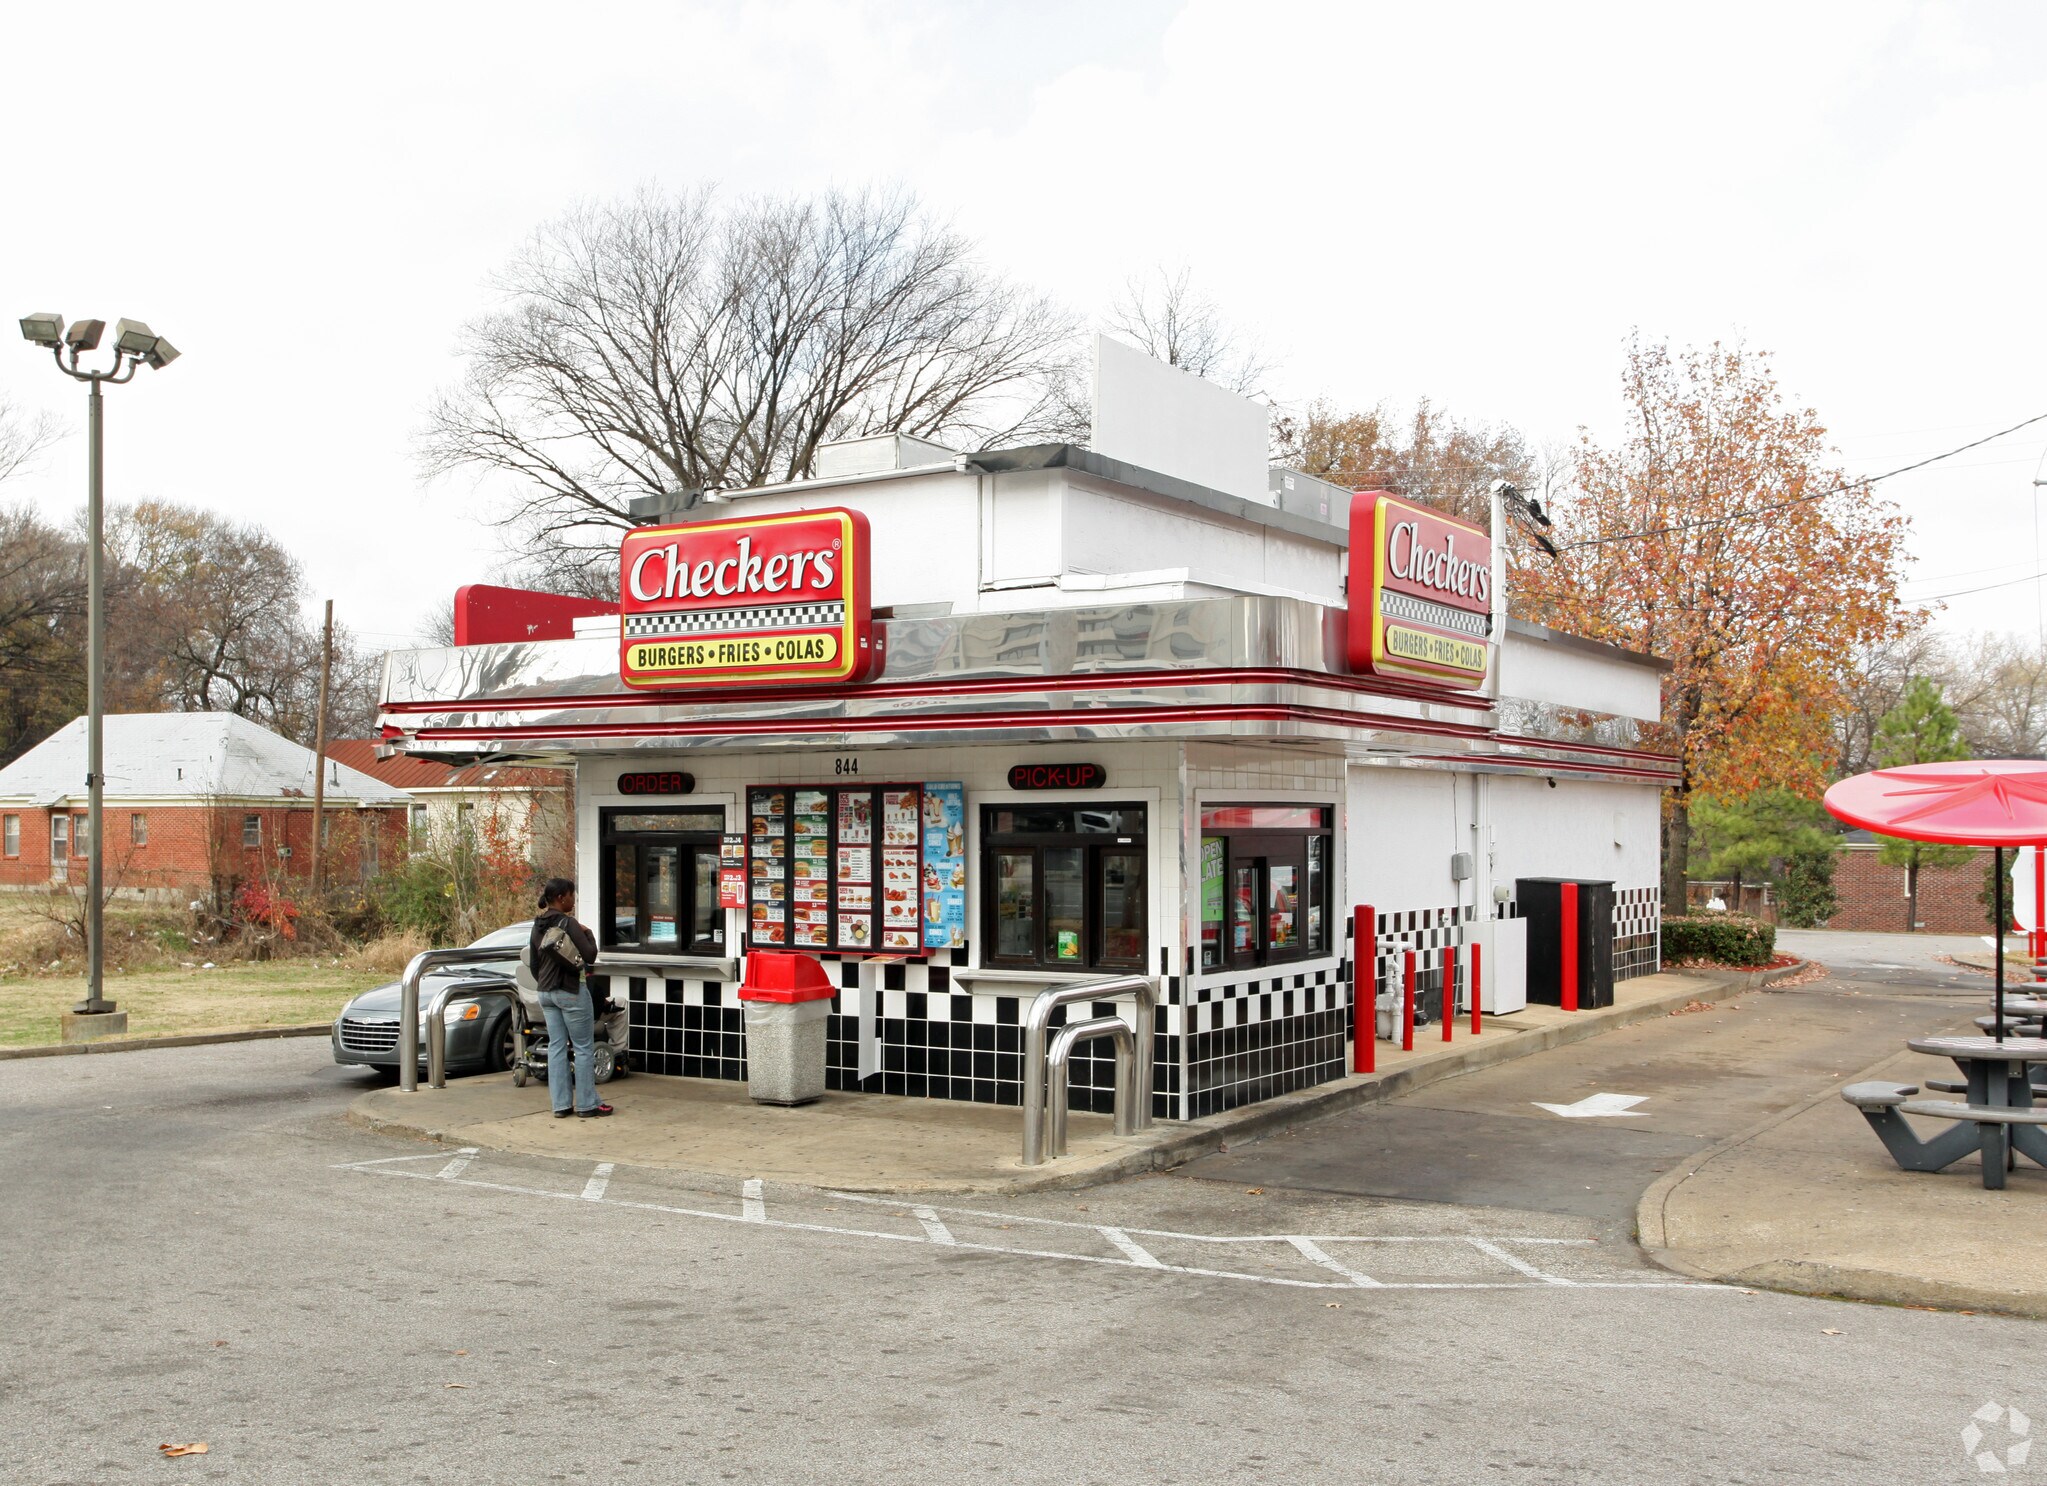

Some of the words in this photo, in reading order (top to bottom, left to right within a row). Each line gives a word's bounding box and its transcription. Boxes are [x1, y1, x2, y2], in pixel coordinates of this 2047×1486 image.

[629, 536, 836, 602] Checkers
[1389, 521, 1489, 602] Checkers
[638, 645, 704, 667] BURGERS
[719, 642, 760, 663] FRIES
[776, 639, 824, 661] COLAS
[1393, 631, 1428, 657] BURGERS
[1434, 640, 1454, 660] FRIES
[1460, 646, 1482, 668] COLAS
[835, 758, 858, 775] 844
[1015, 766, 1095, 787] PICK-UP
[623, 774, 681, 793] ORDER
